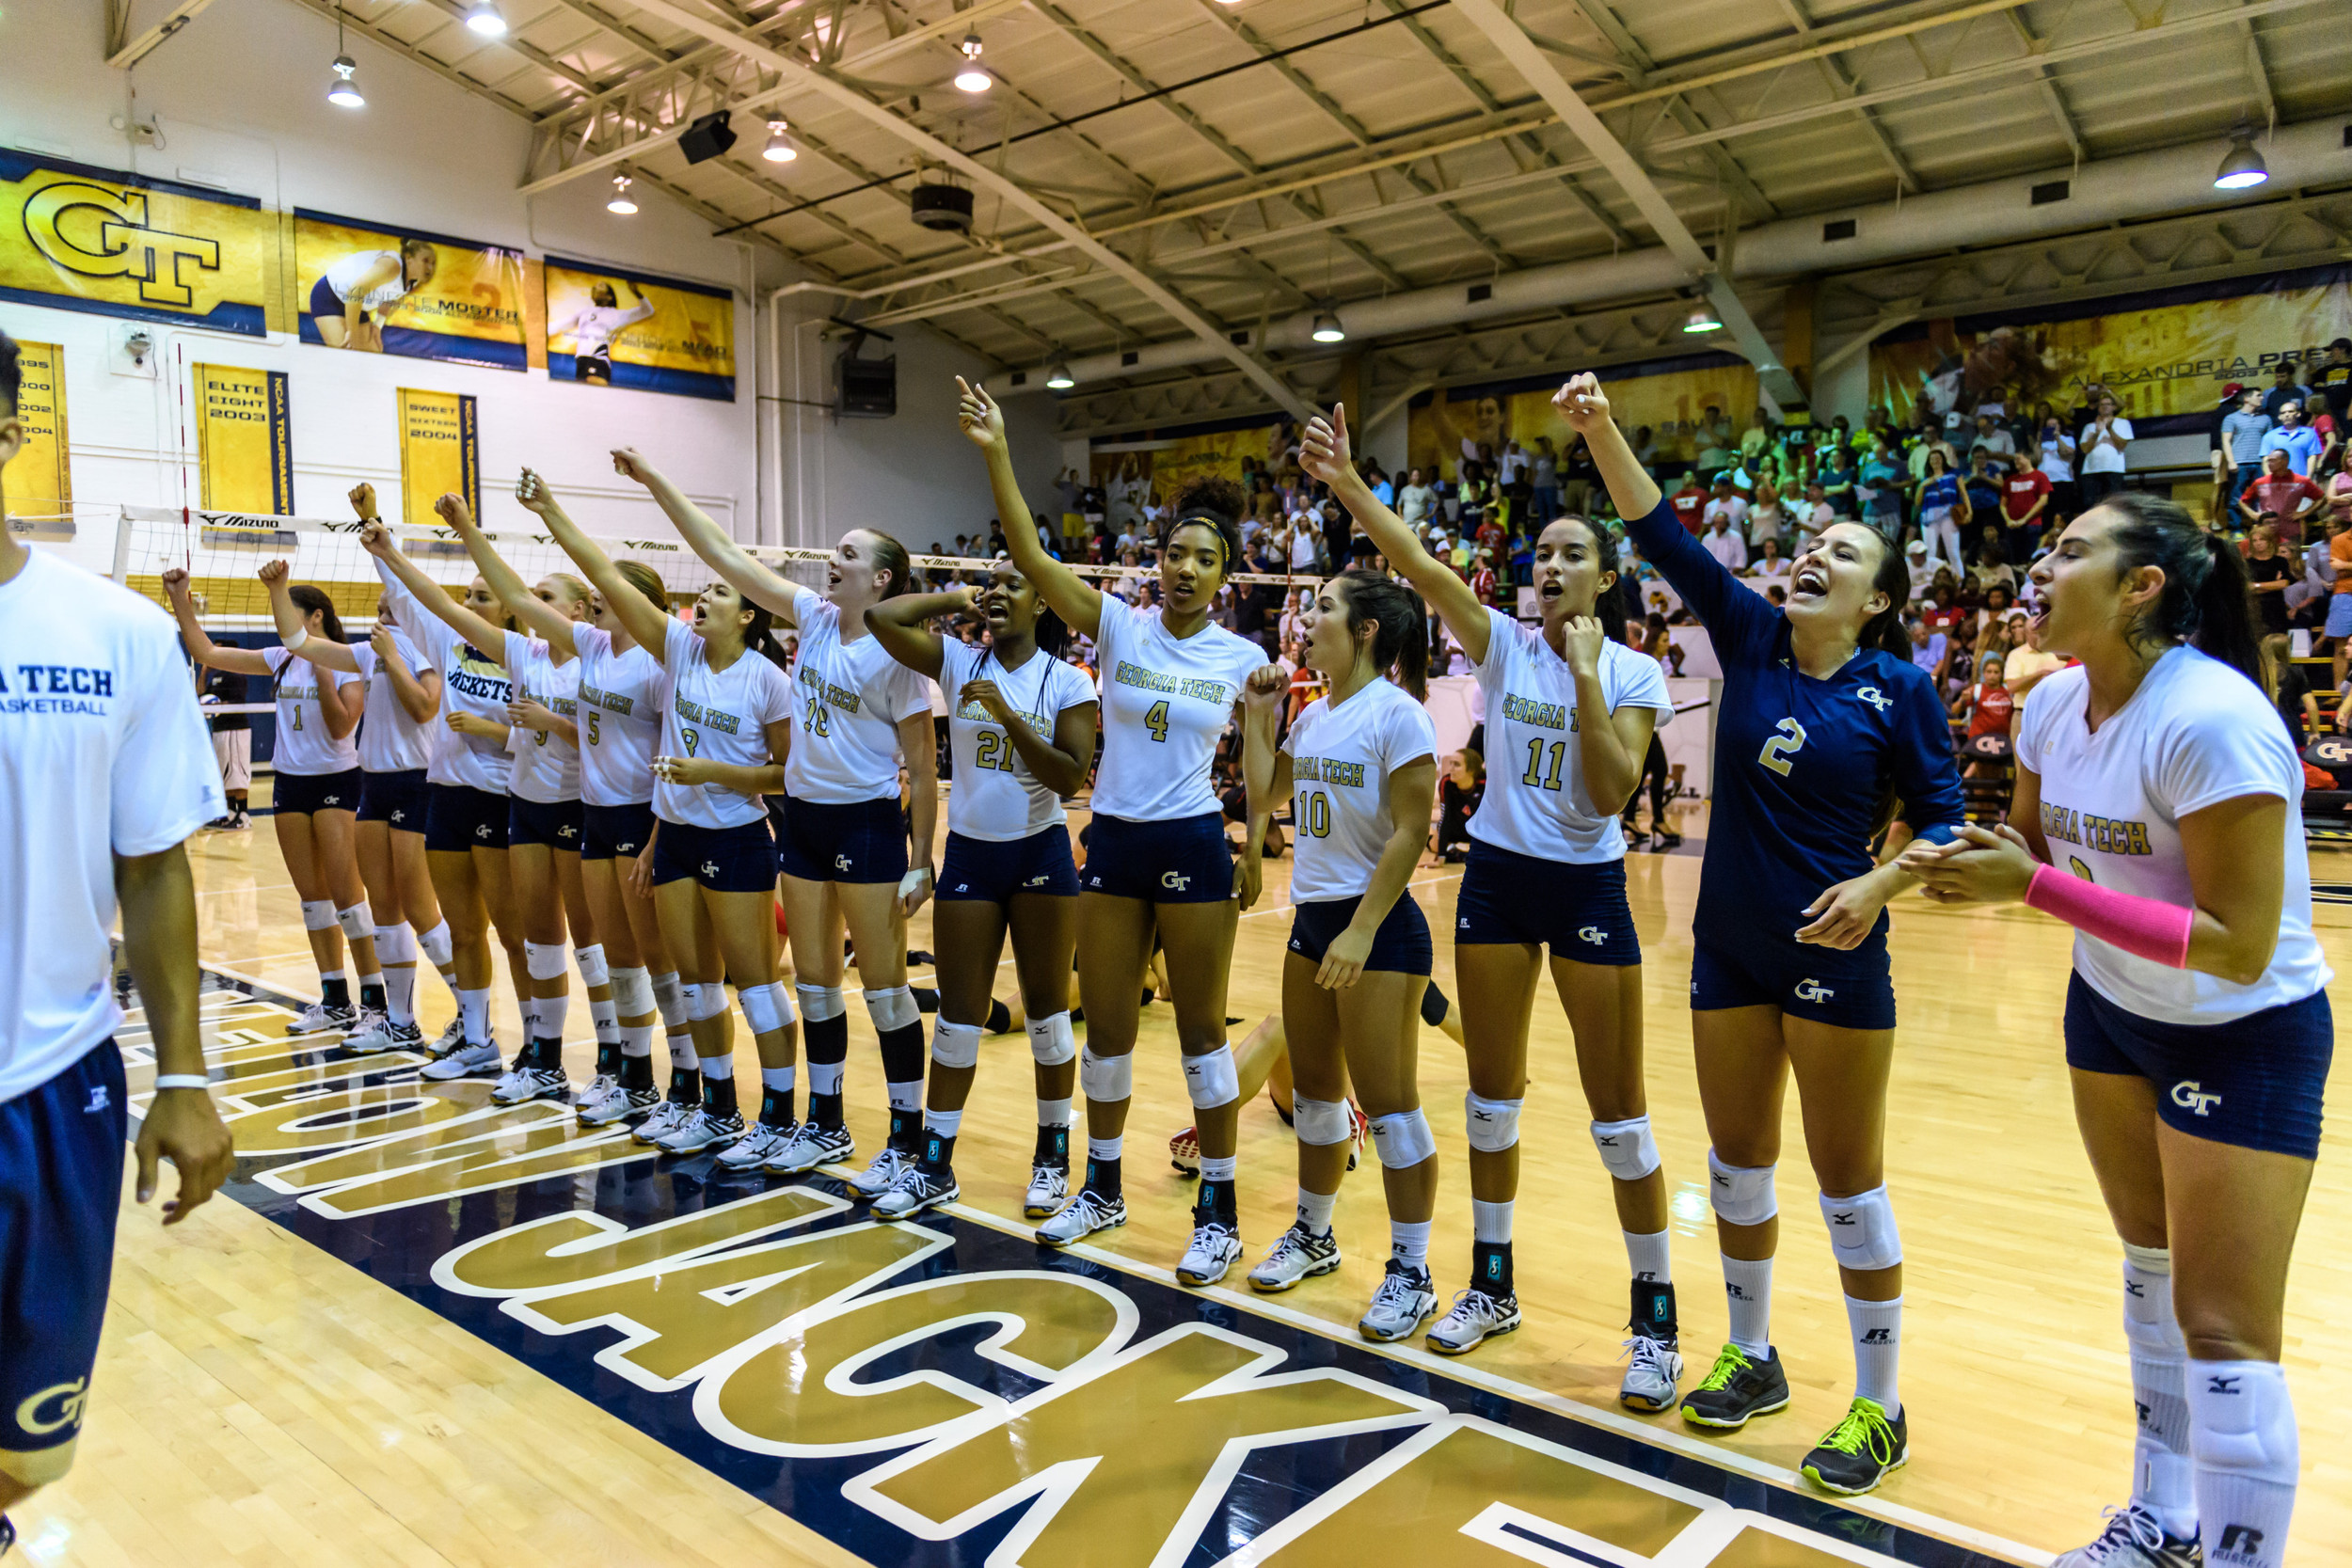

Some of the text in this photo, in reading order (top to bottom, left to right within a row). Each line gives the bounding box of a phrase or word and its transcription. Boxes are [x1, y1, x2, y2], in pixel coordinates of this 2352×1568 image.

[23, 182, 219, 309] GT
[438, 299, 519, 321] MOSTER
[209, 381, 264, 395] ELITE
[210, 396, 264, 407] EIGHT
[409, 404, 455, 414] SWEET
[211, 409, 265, 421] 2003
[465, 400, 474, 436] NCAA
[275, 377, 290, 515] NCAA TOURNAMENT
[410, 429, 456, 440] 2004
[224, 515, 279, 530] MIZUNO
[641, 541, 678, 552] MIZUNO
[19, 664, 112, 698] TECH
[448, 666, 513, 704] JACKETS
[1115, 660, 1226, 705] GEORGIA TECH
[551, 697, 578, 717] TEC
[603, 691, 634, 717] TECH
[826, 683, 861, 715] TECH
[1856, 686, 1894, 712] GT
[293, 704, 304, 732] 1
[587, 710, 600, 746] 5
[705, 708, 740, 736] TECH
[1144, 700, 1169, 743] 4
[976, 731, 1014, 772] 21
[1758, 716, 1807, 778] 2
[1977, 736, 2005, 754] GT
[2316, 742, 2352, 762] GT
[1321, 758, 1365, 788] TECH
[1522, 737, 1566, 792] 11
[1298, 790, 1331, 839] 10
[476, 824, 492, 839] GT
[558, 824, 577, 839] GT
[2083, 814, 2153, 856] TECH
[702, 860, 720, 879] GT
[835, 854, 852, 872] GT
[1161, 871, 1191, 892] GT
[1578, 926, 1609, 945] GT
[1794, 977, 1835, 1004] GT
[2170, 1080, 2221, 1117] GT
